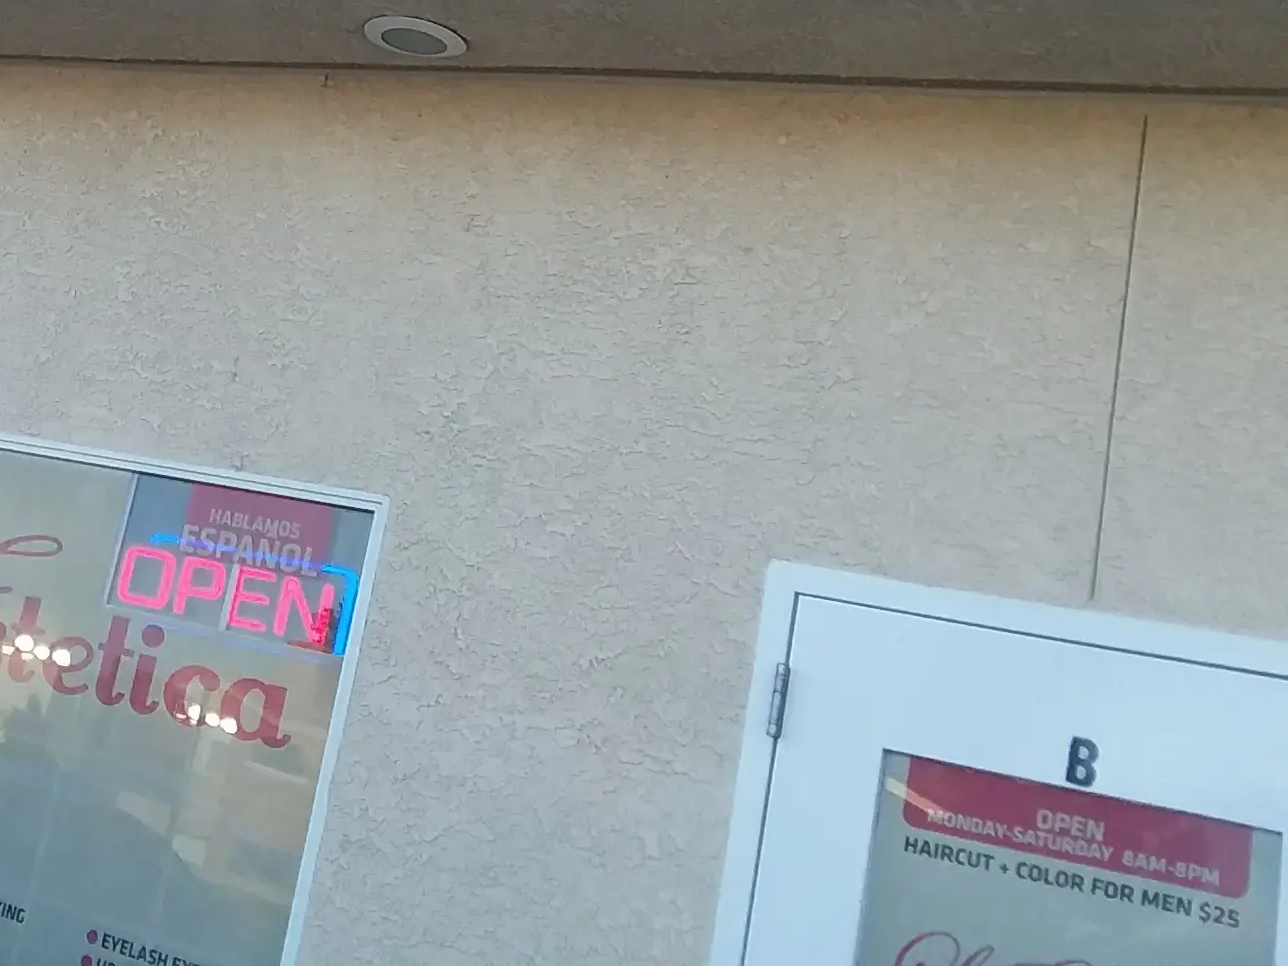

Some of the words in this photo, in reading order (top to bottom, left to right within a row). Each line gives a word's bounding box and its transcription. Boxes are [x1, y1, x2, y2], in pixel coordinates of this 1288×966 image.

[208, 508, 301, 537] HABLAMOS
[117, 545, 335, 647] OPEN
[1065, 734, 1099, 787] B
[926, 807, 1114, 862] MONDAY-SATURDAY
[1035, 808, 1106, 841] OPEN
[903, 835, 996, 872] HAIRCUT
[999, 863, 1010, 875] +
[1015, 861, 1086, 894] COLOR
[1090, 877, 1135, 904] FOR
[1141, 888, 1193, 918] MEN
[1198, 901, 1242, 930] $25
[101, 932, 169, 966] EYELASH
